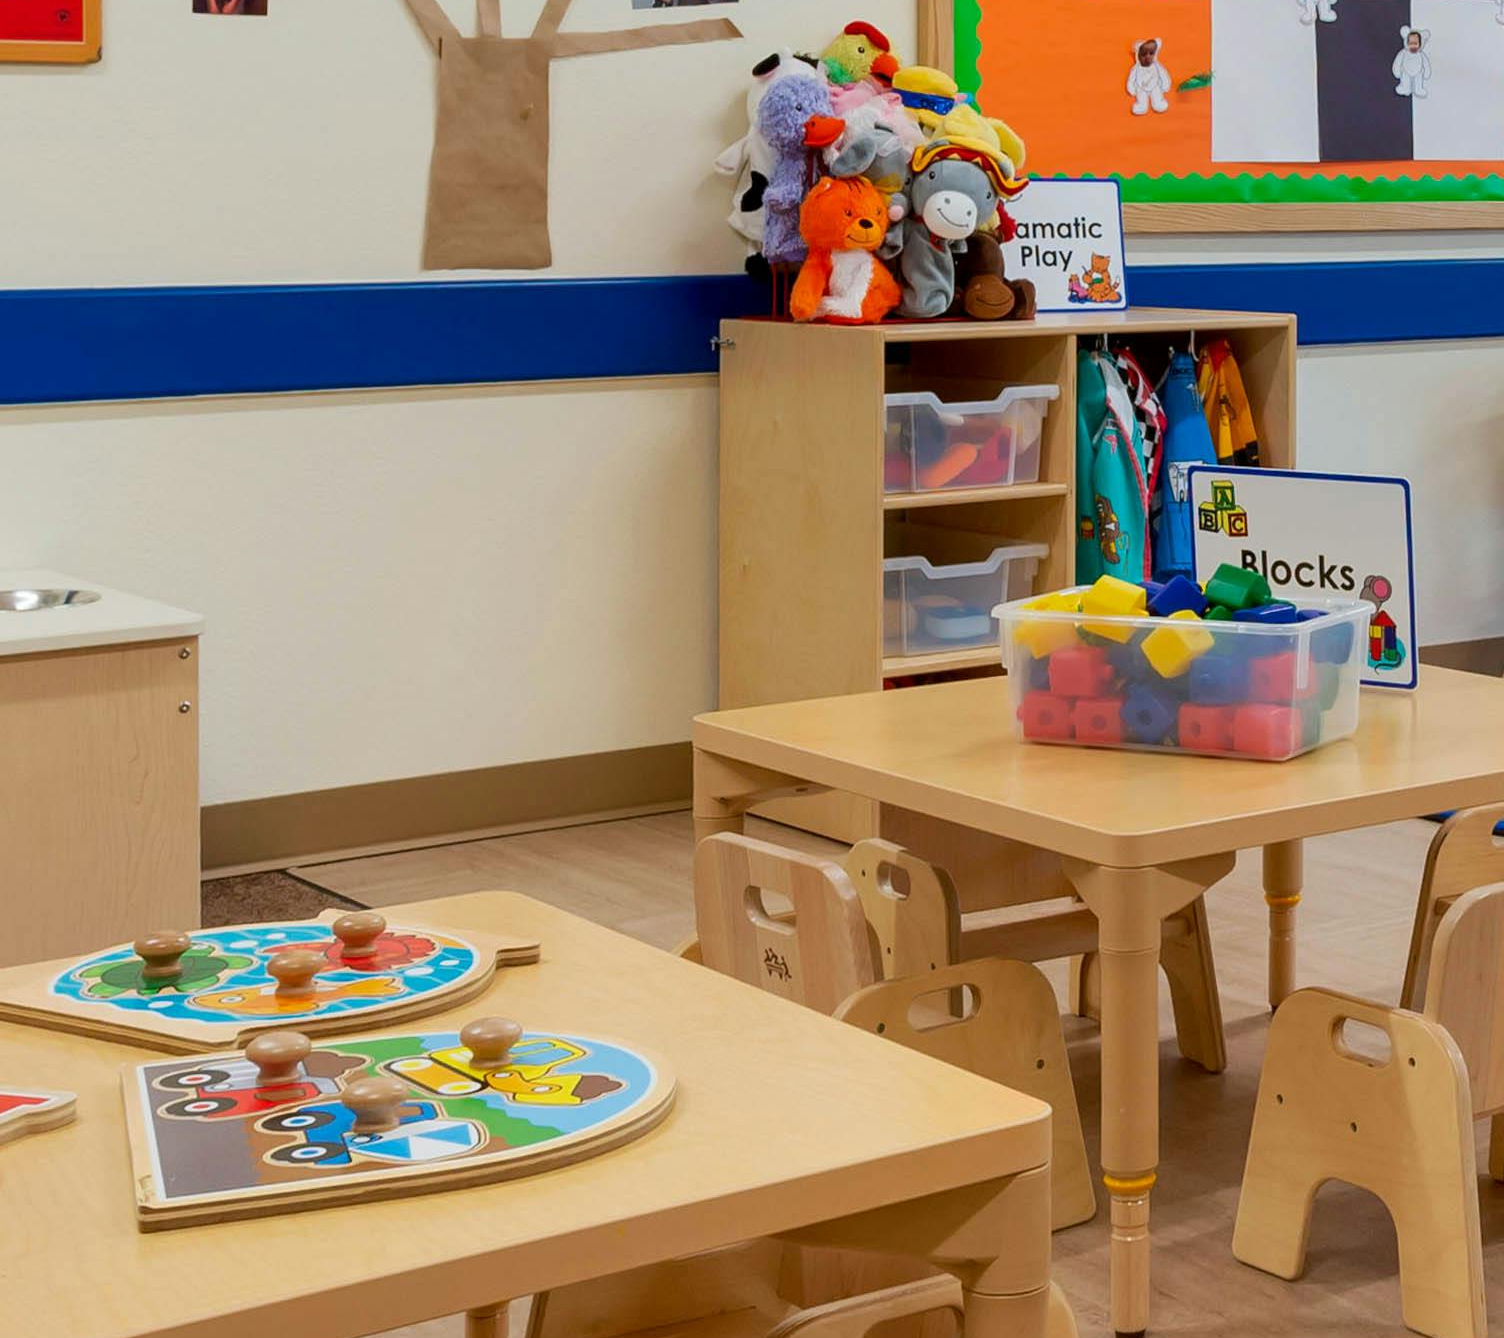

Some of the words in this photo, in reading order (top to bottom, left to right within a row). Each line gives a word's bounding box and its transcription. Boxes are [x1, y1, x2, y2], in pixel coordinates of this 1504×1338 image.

[1016, 217, 1103, 239] amatic
[1021, 245, 1073, 271] Play
[1241, 549, 1355, 591] Blocks
